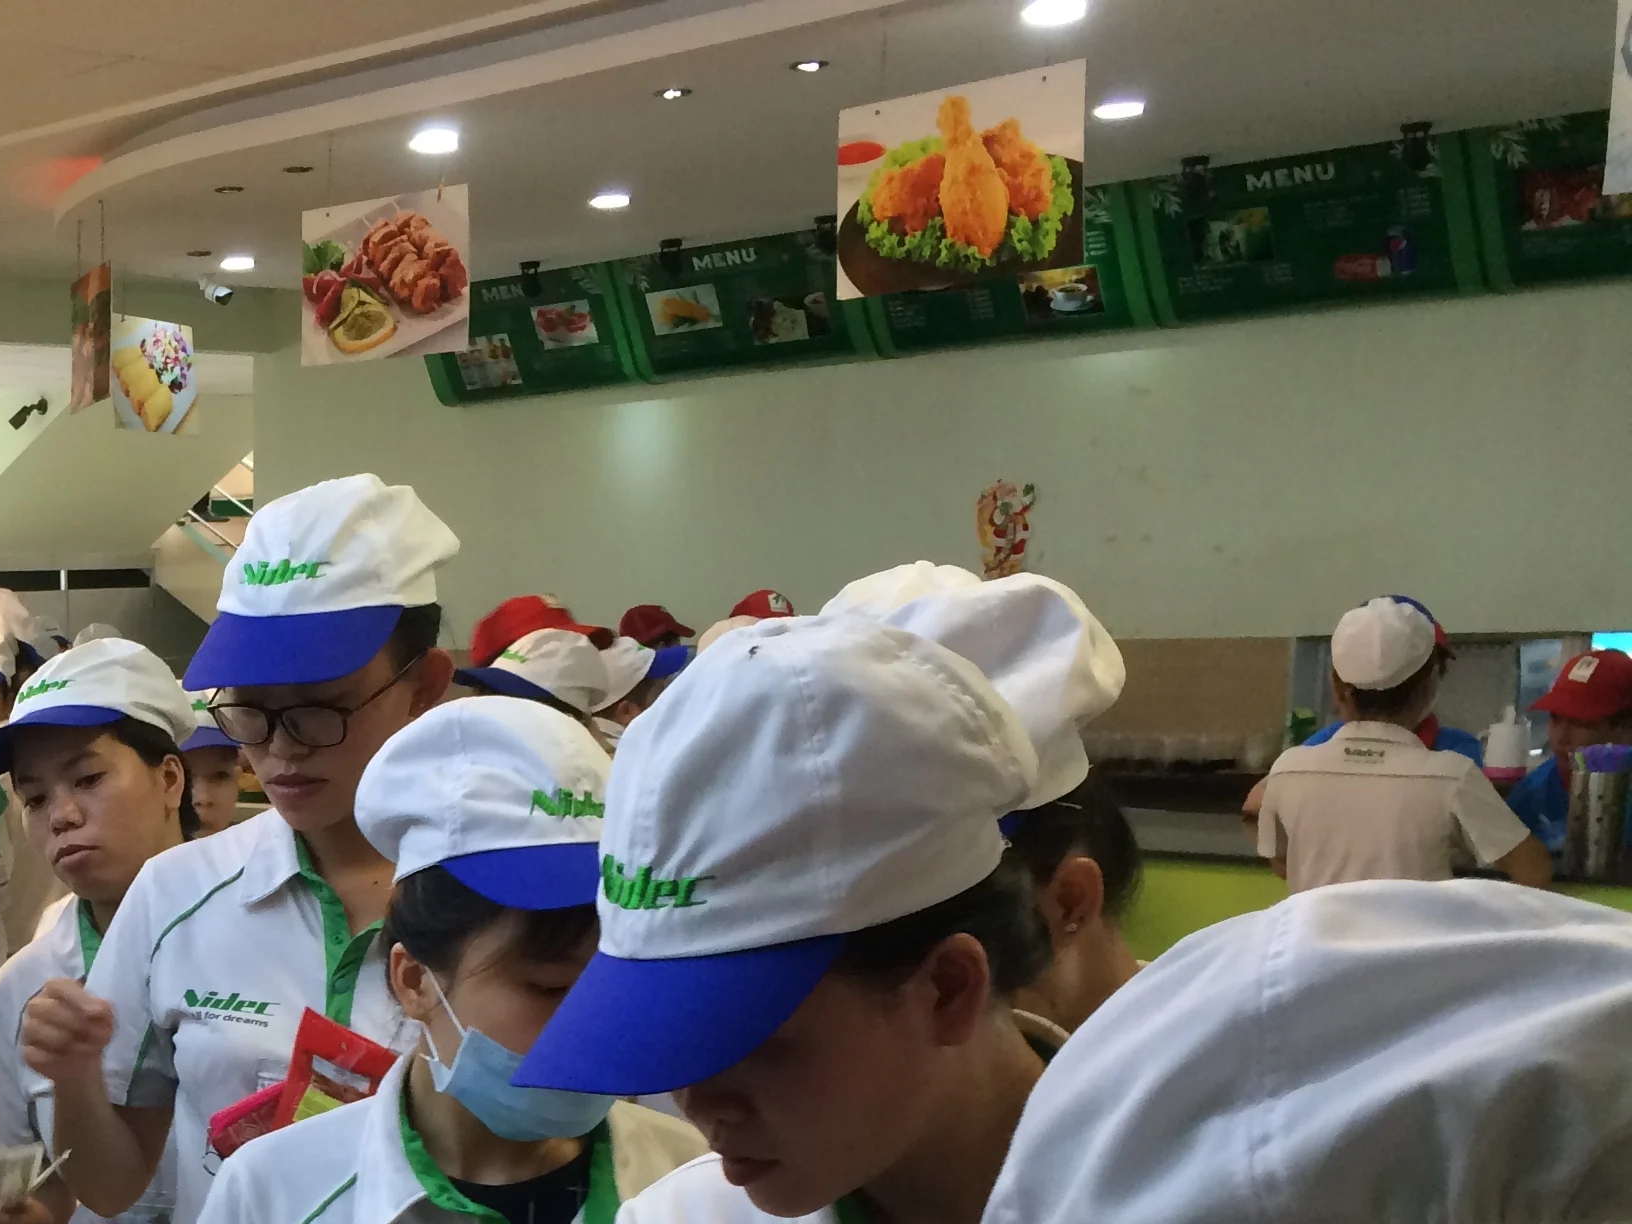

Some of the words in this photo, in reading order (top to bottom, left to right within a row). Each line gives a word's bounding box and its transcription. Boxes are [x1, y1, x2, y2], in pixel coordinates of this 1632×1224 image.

[1244, 161, 1336, 192] MENU
[691, 247, 757, 272] MENU
[481, 282, 525, 302] MEN
[184, 989, 280, 1016] Nidec
[204, 1011, 222, 1020] for
[222, 1014, 269, 1028] dreams
